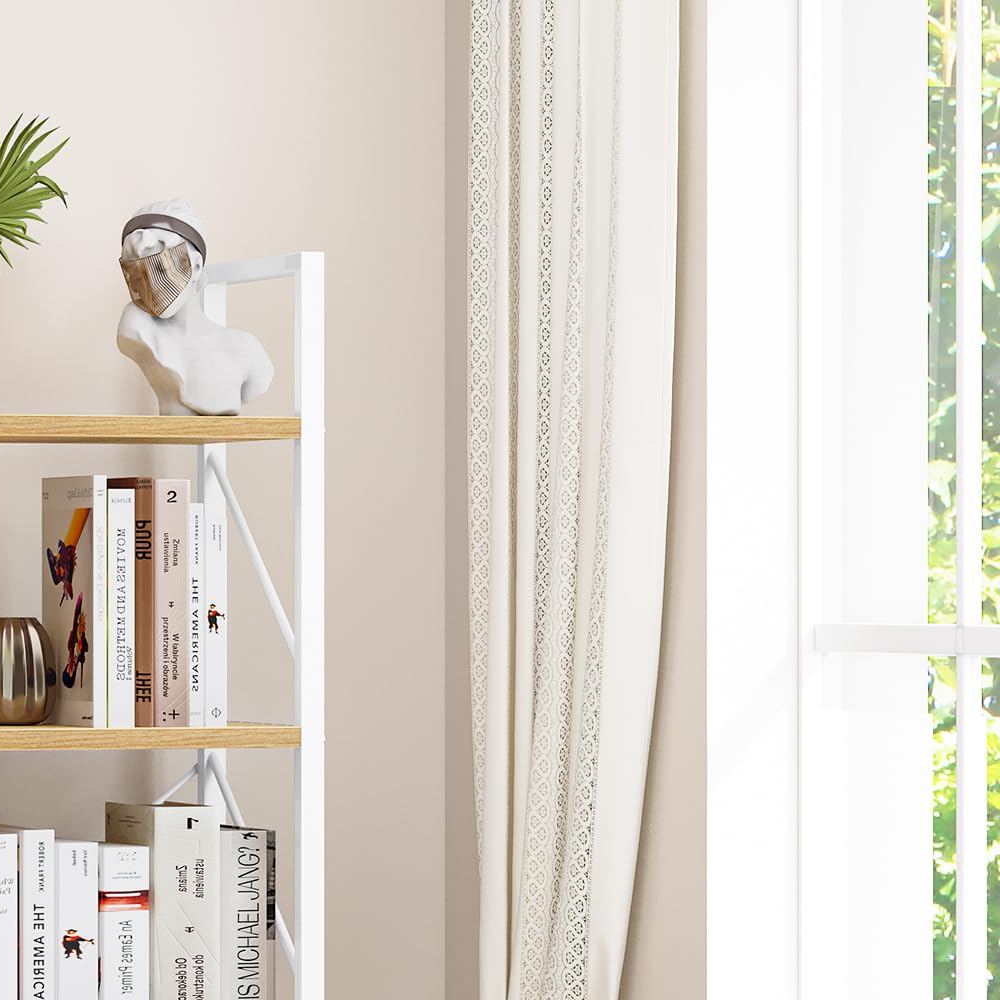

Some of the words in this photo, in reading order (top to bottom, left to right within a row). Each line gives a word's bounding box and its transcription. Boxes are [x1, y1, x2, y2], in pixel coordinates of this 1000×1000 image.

[167, 490, 177, 503] 2
[162, 616, 170, 660] przestrzeni
[238, 846, 260, 900] JANG?
[237, 903, 260, 980] MICHAEL
[238, 984, 260, 1000] IS
